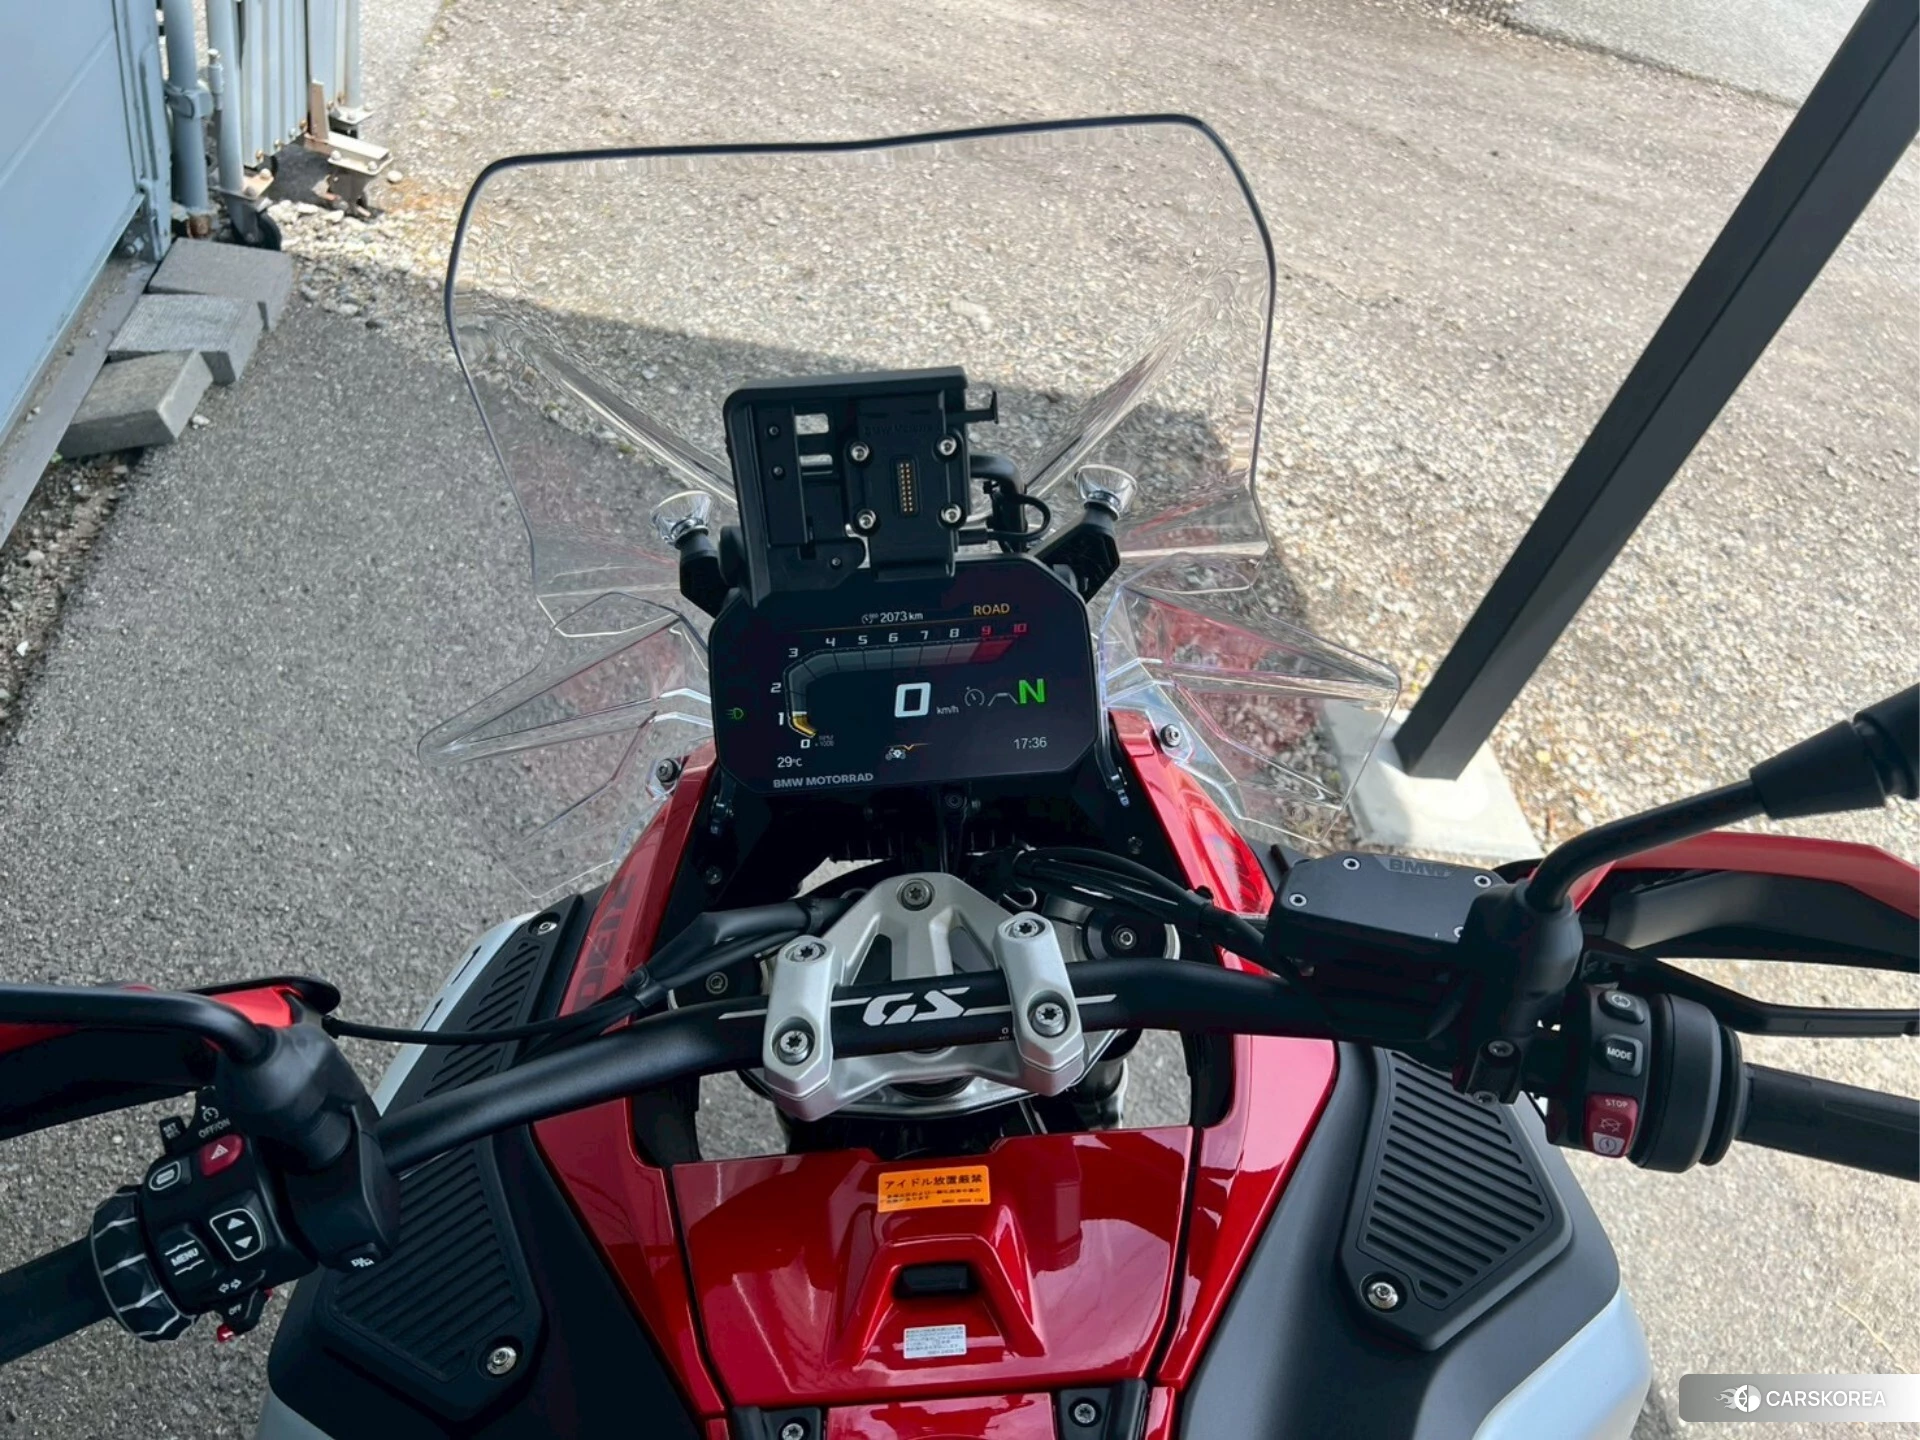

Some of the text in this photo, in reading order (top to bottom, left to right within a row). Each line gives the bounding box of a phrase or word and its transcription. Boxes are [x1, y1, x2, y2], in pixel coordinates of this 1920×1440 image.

[973, 603, 1010, 616] ROAD
[880, 611, 908, 623] 2073
[909, 612, 924, 621] km
[825, 623, 1028, 647] 4 5 6 7 8 9 10
[788, 647, 799, 658] 3
[770, 682, 782, 693] 2
[1018, 678, 1046, 705] N
[894, 682, 960, 717] 0 km/h
[778, 712, 785, 726] 1
[800, 738, 811, 749] 0
[1014, 736, 1048, 750] 17:36
[773, 772, 874, 789] BMW MOTORRAD
[1388, 858, 1450, 878] BMW
[862, 986, 970, 1027] GS
[1606, 1046, 1633, 1061] MODE
[1605, 1099, 1629, 1109] STOP
[198, 1117, 231, 1139] OFF/ON
[171, 1247, 199, 1267] MENU
[228, 1303, 242, 1316] OFF
